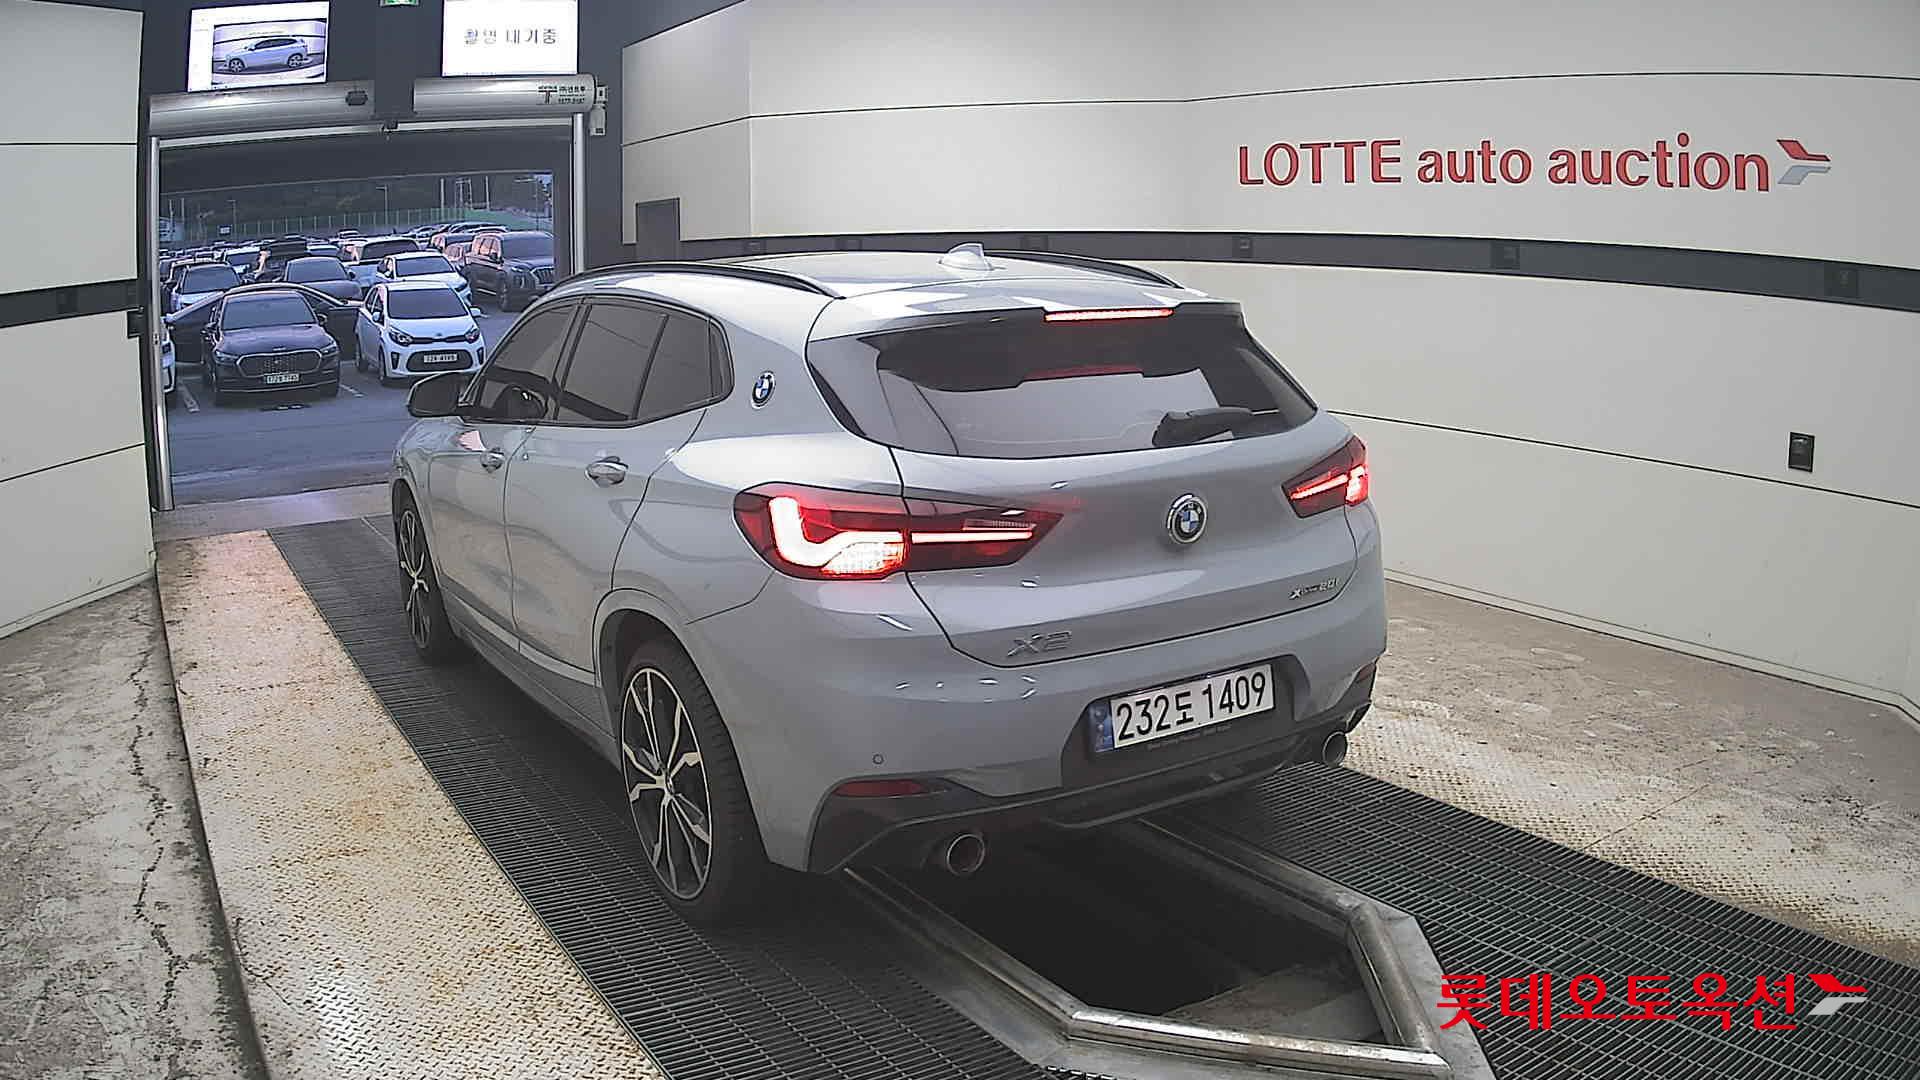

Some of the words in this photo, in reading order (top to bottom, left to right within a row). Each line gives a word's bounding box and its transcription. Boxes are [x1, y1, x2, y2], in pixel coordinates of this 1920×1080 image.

[1238, 139, 1401, 186] LOTTE
[1417, 140, 1532, 185] auto
[1547, 132, 1770, 192] auction
[1116, 691, 1195, 742] 232도
[1202, 672, 1267, 719] 1409
